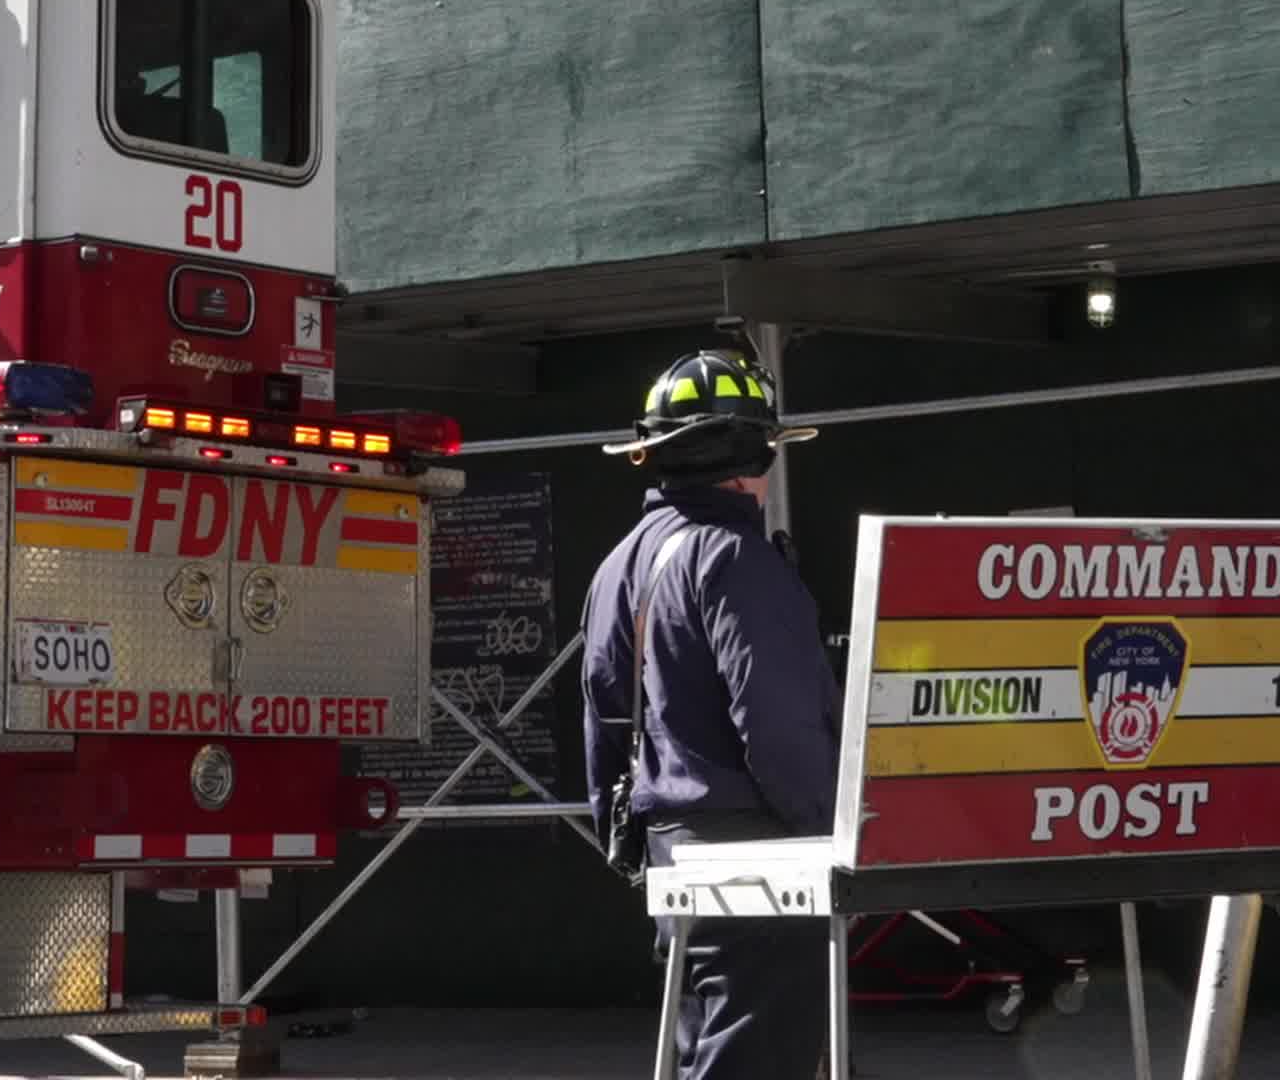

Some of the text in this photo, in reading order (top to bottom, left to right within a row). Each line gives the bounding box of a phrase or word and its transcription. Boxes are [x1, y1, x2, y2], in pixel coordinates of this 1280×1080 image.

[185, 174, 243, 253] 20
[135, 469, 341, 567] FDNY
[34, 636, 111, 672] SOHO
[1109, 656, 1161, 666] NEW YORK
[1115, 646, 1155, 656] CITY OF
[47, 689, 390, 736] KEEP BACK 200 FEET
[911, 676, 1042, 717] DIVISION
[1030, 781, 1209, 841] POST
